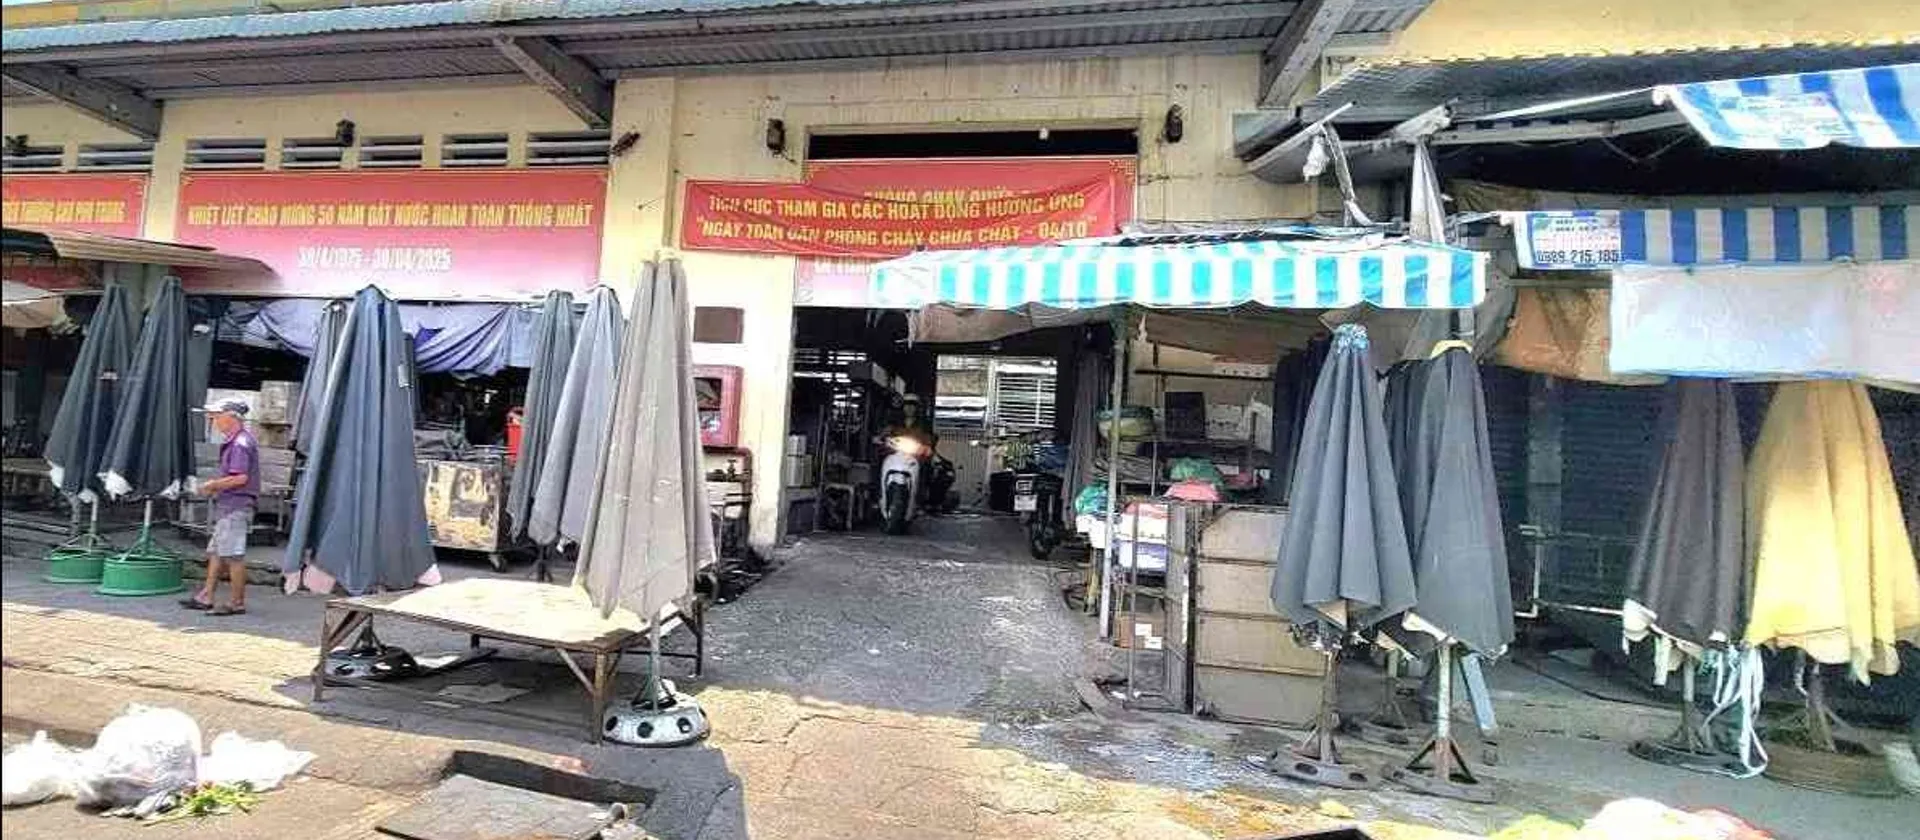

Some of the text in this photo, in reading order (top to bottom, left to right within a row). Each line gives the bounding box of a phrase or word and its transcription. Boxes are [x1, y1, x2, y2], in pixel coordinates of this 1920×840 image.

[776, 200, 817, 217] THAM
[822, 201, 847, 219] GIA
[851, 199, 884, 219] CÁC
